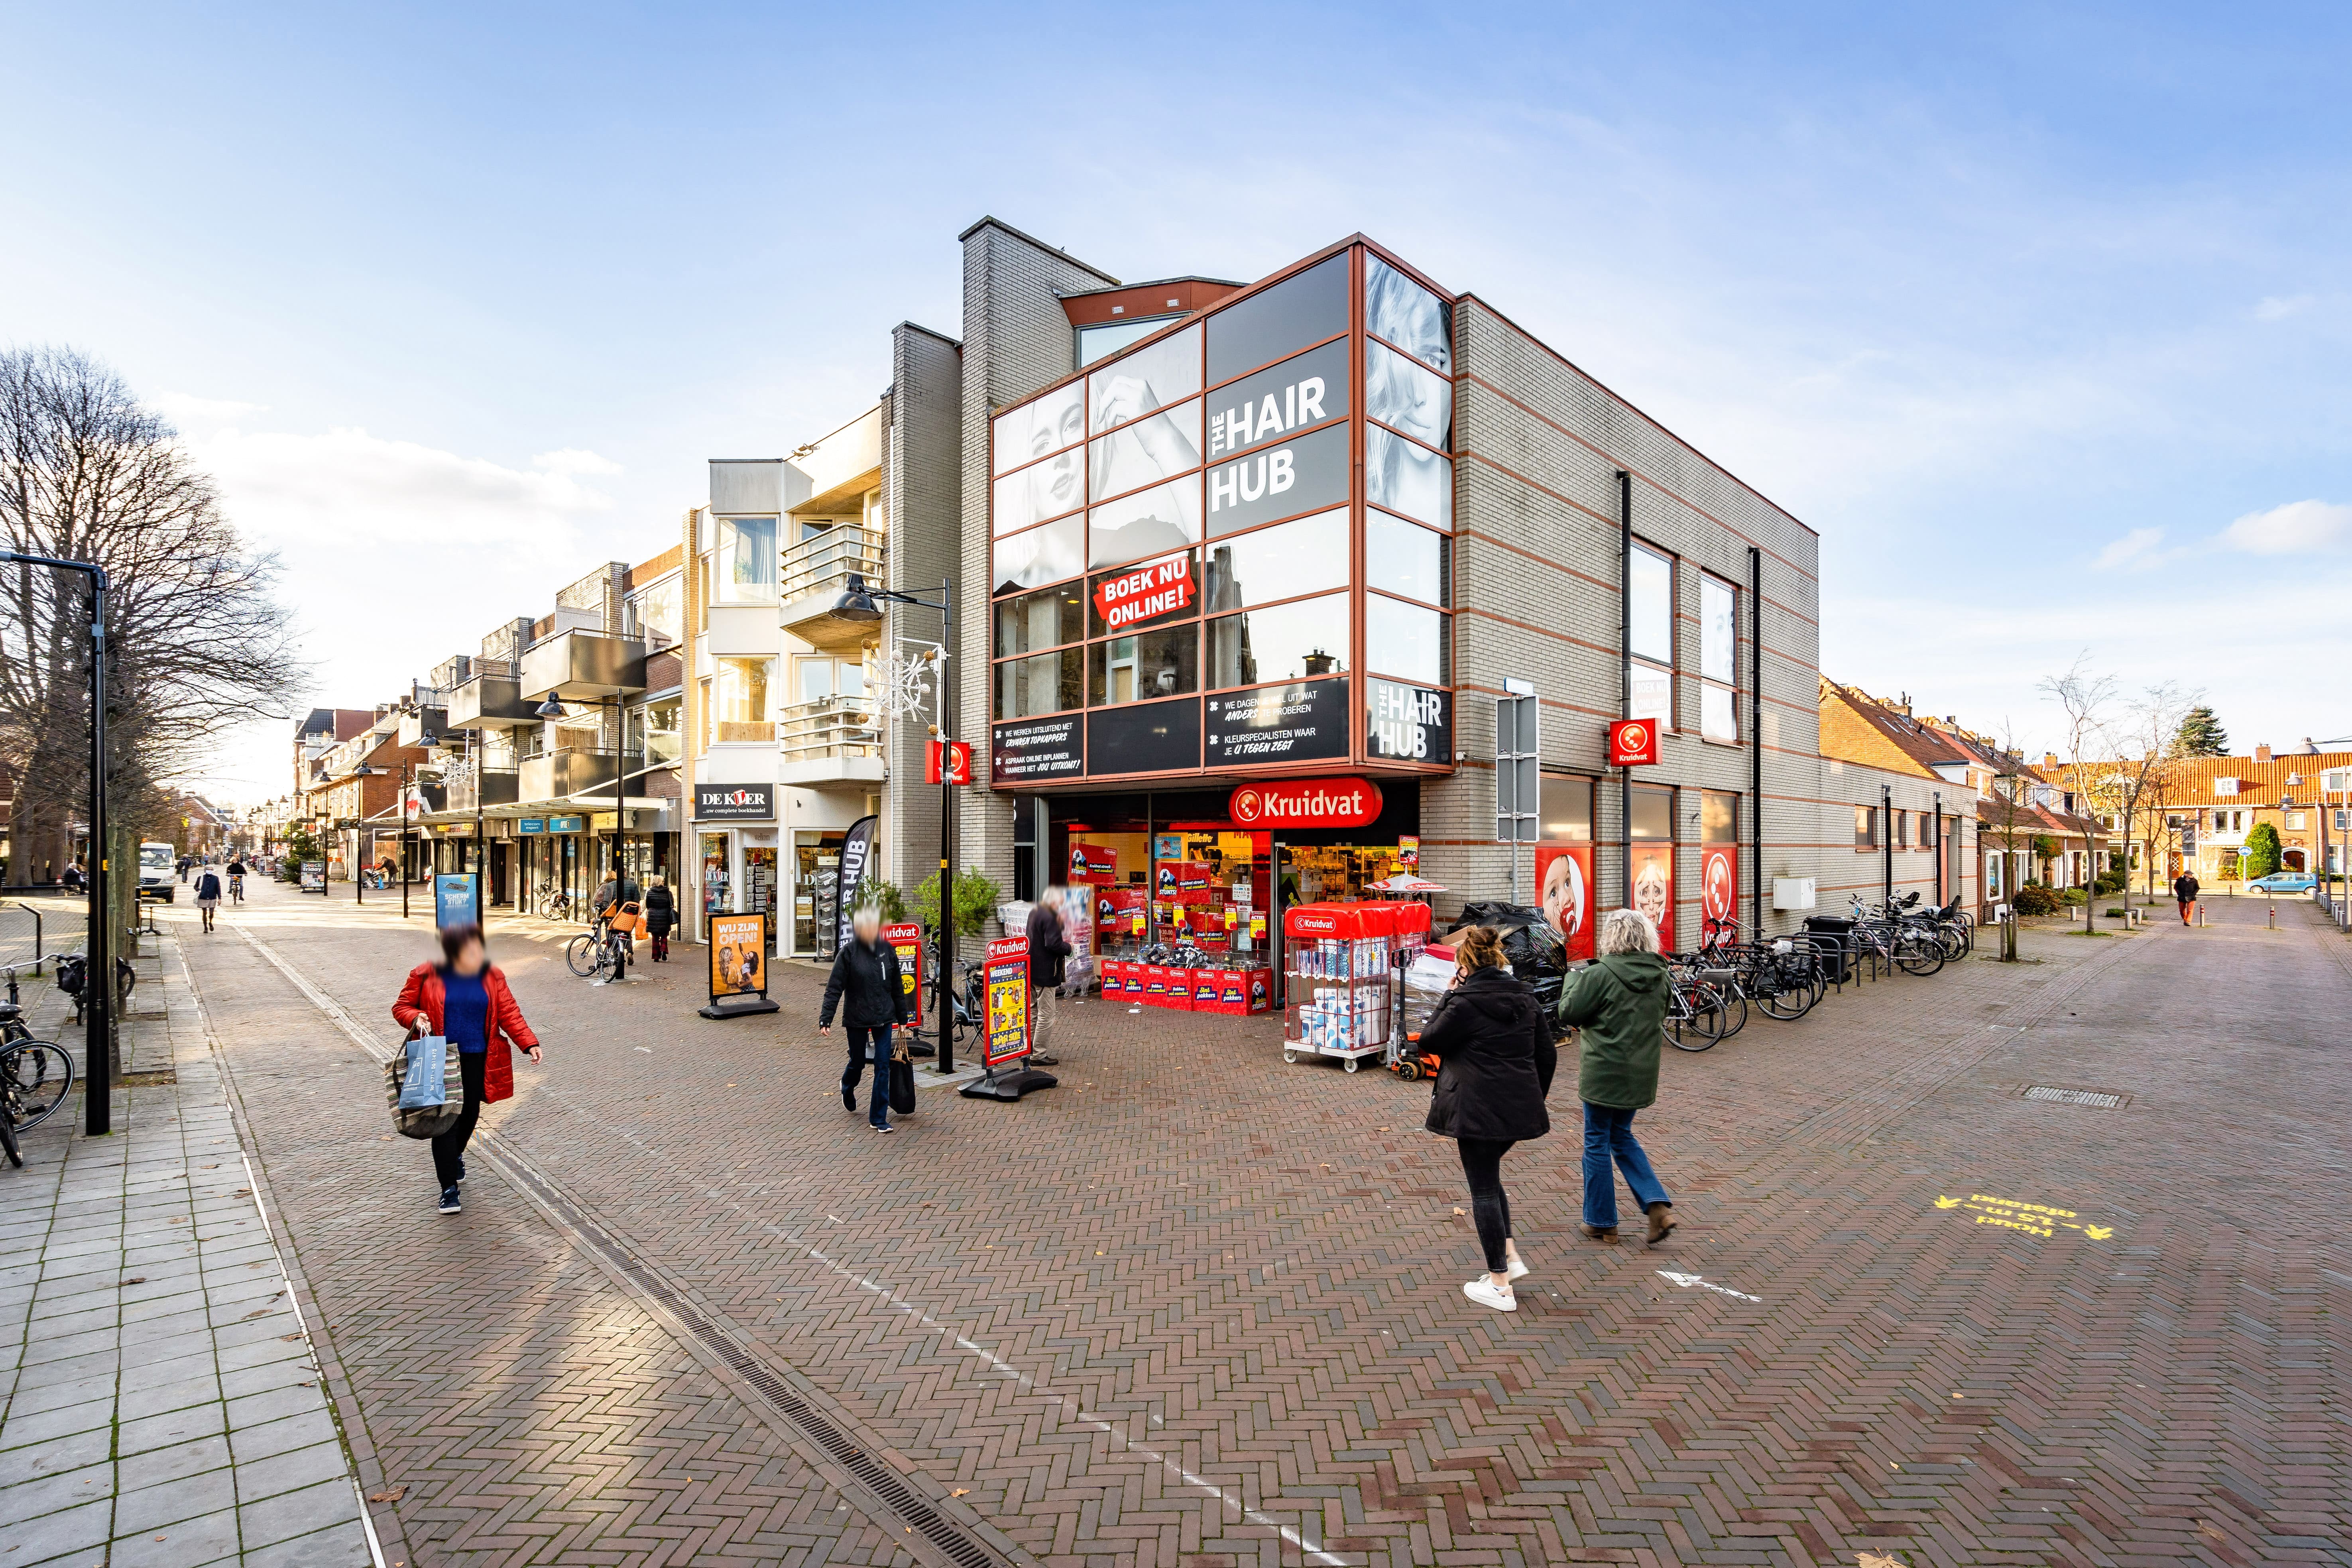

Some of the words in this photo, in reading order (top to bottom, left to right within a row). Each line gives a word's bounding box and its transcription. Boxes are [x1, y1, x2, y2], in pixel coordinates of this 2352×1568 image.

[1212, 412, 1224, 456] THE
[1227, 377, 1326, 451] HAIR
[1212, 449, 1295, 512] HUB
[1105, 569, 1154, 602] BOEK
[1159, 559, 1186, 584] NU
[1109, 584, 1184, 625] ONLINE!
[1636, 682, 1655, 694] BOEK
[1656, 681, 1666, 693] NU
[1225, 701, 1235, 710] WE
[1237, 698, 1259, 708] DAGEN
[1288, 693, 1300, 702] UIT
[1301, 691, 1317, 700] WAT
[1379, 684, 1387, 717] THE
[1388, 685, 1442, 726] HAIR
[1225, 708, 1259, 722] ANDERS
[1273, 704, 1311, 716] PROBEREN
[1032, 724, 1061, 734] UITSLUITEND
[1225, 730, 1292, 744] KLEURSPECIALISTEN
[1294, 728, 1316, 737] WAAR
[1005, 736, 1031, 748] ERVAREN
[1030, 732, 1068, 744] TOPKAPPERS
[1379, 720, 1427, 758] HUB
[1225, 747, 1232, 755] JE
[1234, 744, 1242, 754] U
[1243, 742, 1271, 754] TEGEN
[1271, 740, 1294, 752] ZEGT
[1005, 756, 1025, 765] ASPRAAK
[1043, 752, 1069, 761] INPLANNEN
[1037, 763, 1049, 771] JOU
[1050, 759, 1081, 770] UITKOMT!
[702, 793, 722, 805] DE
[724, 790, 765, 806] KLER
[1264, 789, 1363, 817] Kruidvat
[754, 833, 770, 841] welkom
[1188, 833, 1212, 842] Gillette
[844, 840, 866, 884] HUB
[718, 924, 736, 933] WIJ
[738, 922, 758, 932] ZIJN
[1305, 919, 1333, 929] Kruidvat
[719, 932, 757, 945] OPEN!
[895, 945, 916, 955] SIZE
[997, 940, 1026, 955] Kruidvat
[991, 968, 1012, 978] WEEKEND
[1009, 1031, 1021, 1041] SIZE
[1970, 1194, 2077, 1218] afstand
[1986, 1206, 2012, 1216] m
[1976, 1216, 2052, 1237] Houd
